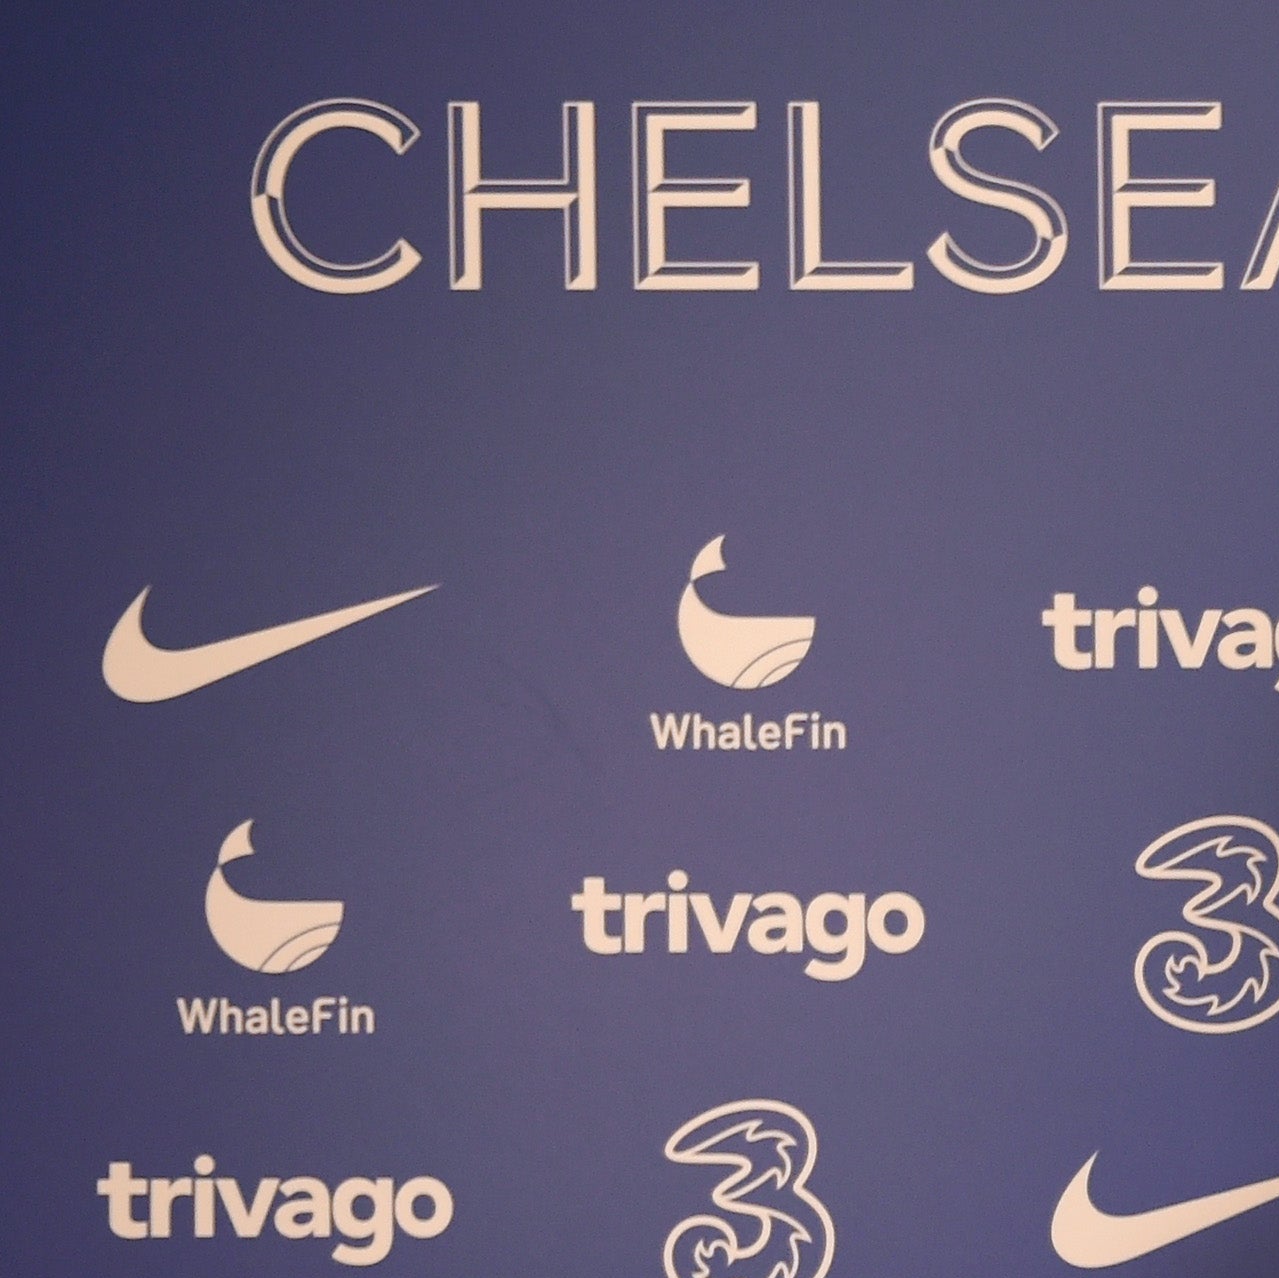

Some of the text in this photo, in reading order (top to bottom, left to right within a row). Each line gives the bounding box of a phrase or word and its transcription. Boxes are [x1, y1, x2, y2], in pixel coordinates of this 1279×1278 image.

[650, 712, 846, 750] WhaleFin
[571, 870, 925, 981] trivago
[177, 996, 374, 1034] WhaleFin
[97, 1154, 453, 1266] trivago
